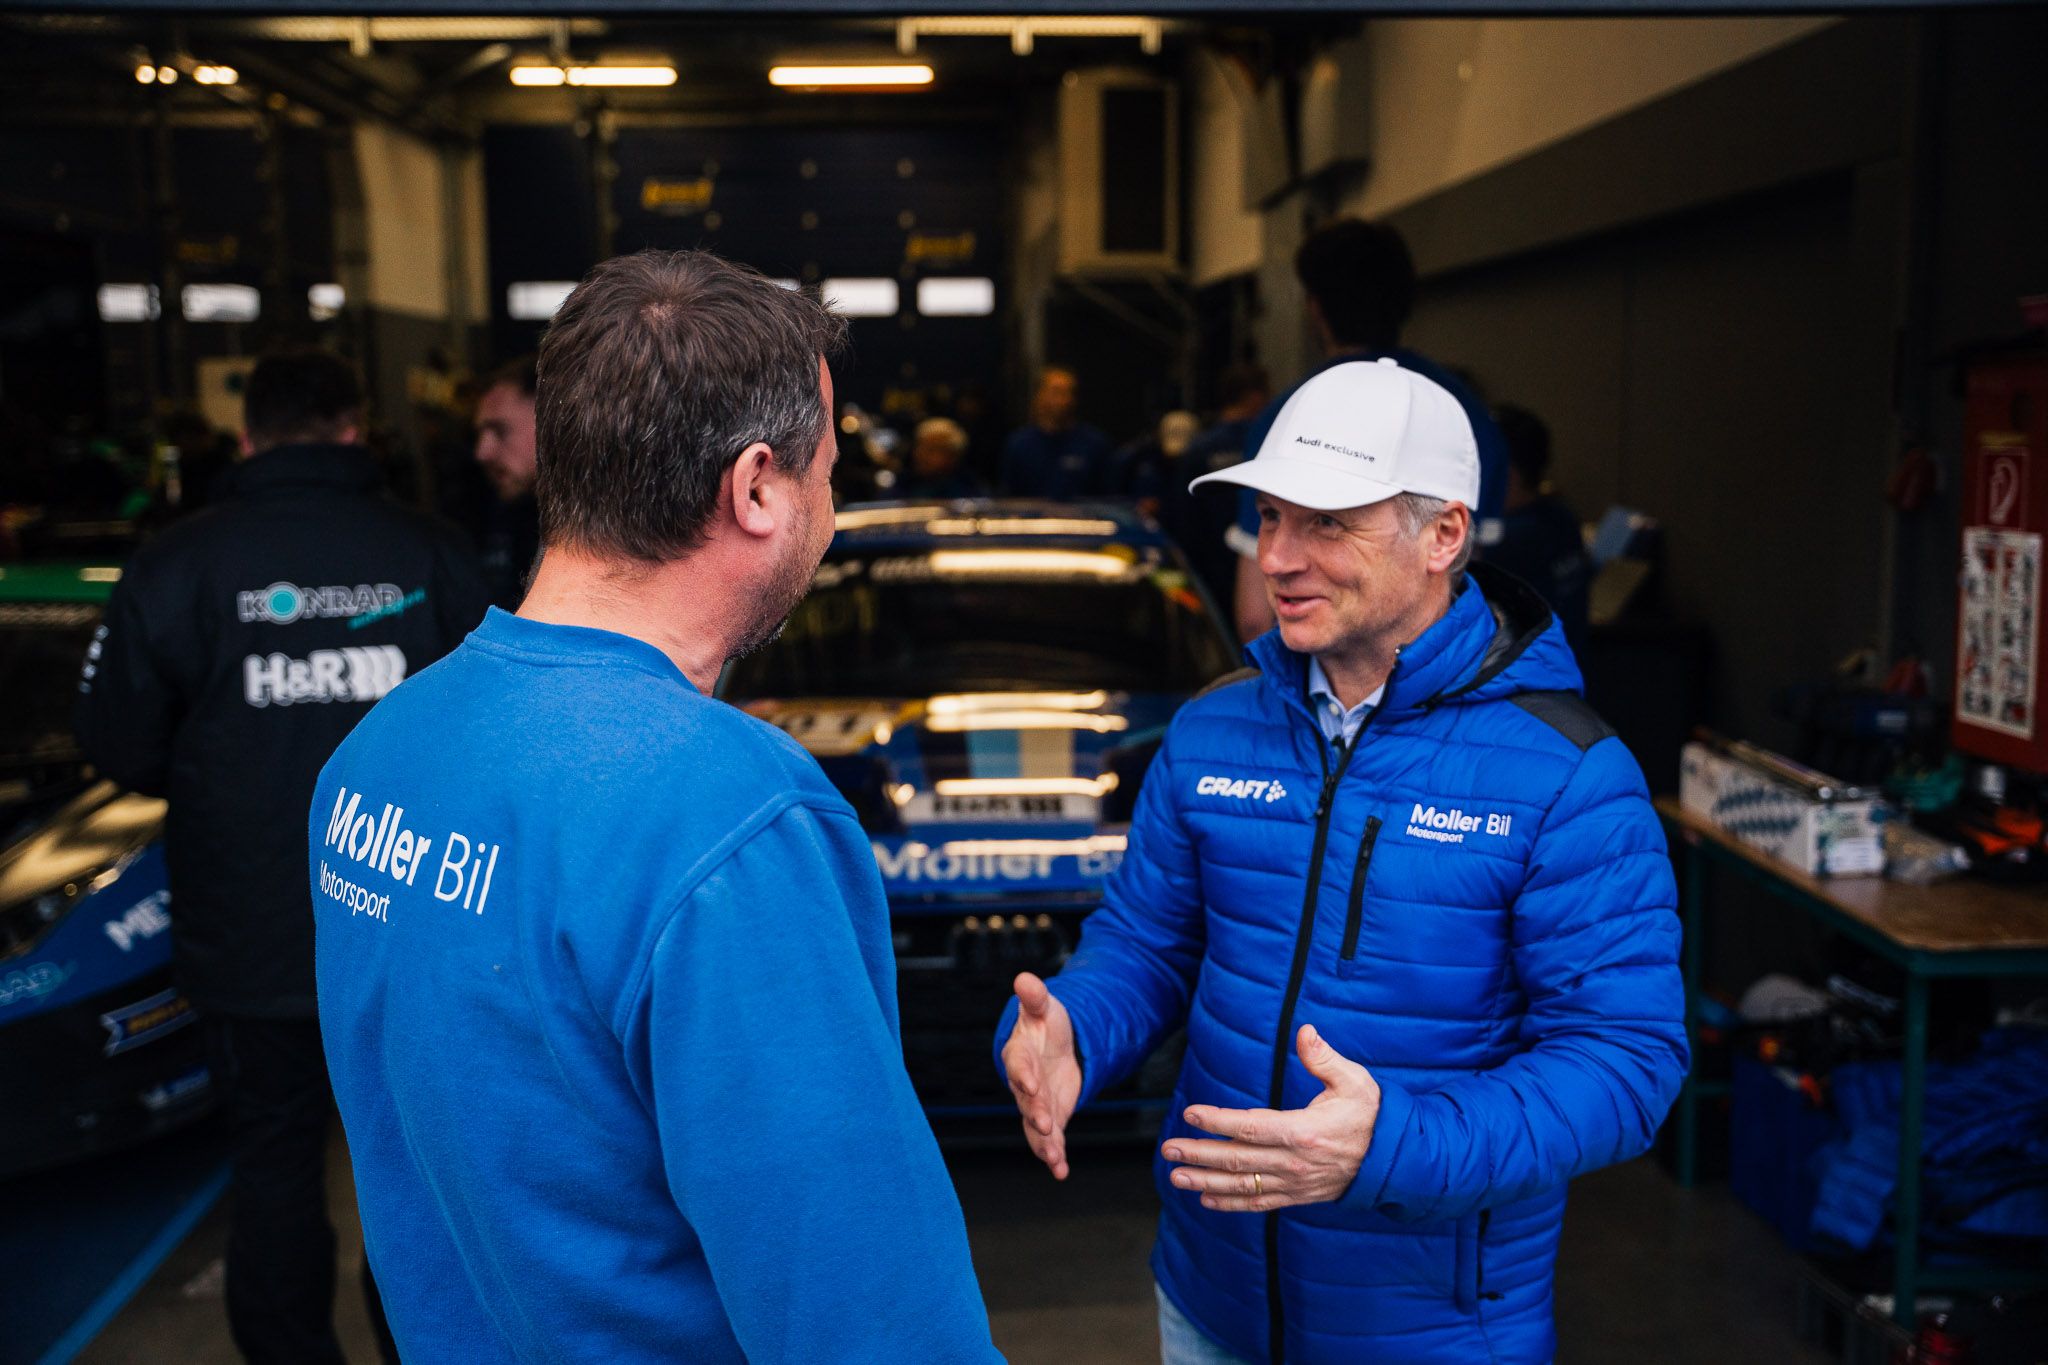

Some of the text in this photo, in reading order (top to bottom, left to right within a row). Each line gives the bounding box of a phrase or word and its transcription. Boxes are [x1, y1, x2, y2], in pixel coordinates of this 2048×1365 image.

[1295, 436, 1375, 462] Audi exclusive
[1196, 775, 1270, 800] CRAFT
[1406, 824, 1464, 843] Motorsport
[1486, 813, 1512, 837] Bil
[433, 831, 500, 915] Bil
[319, 859, 391, 923] Motorsport
